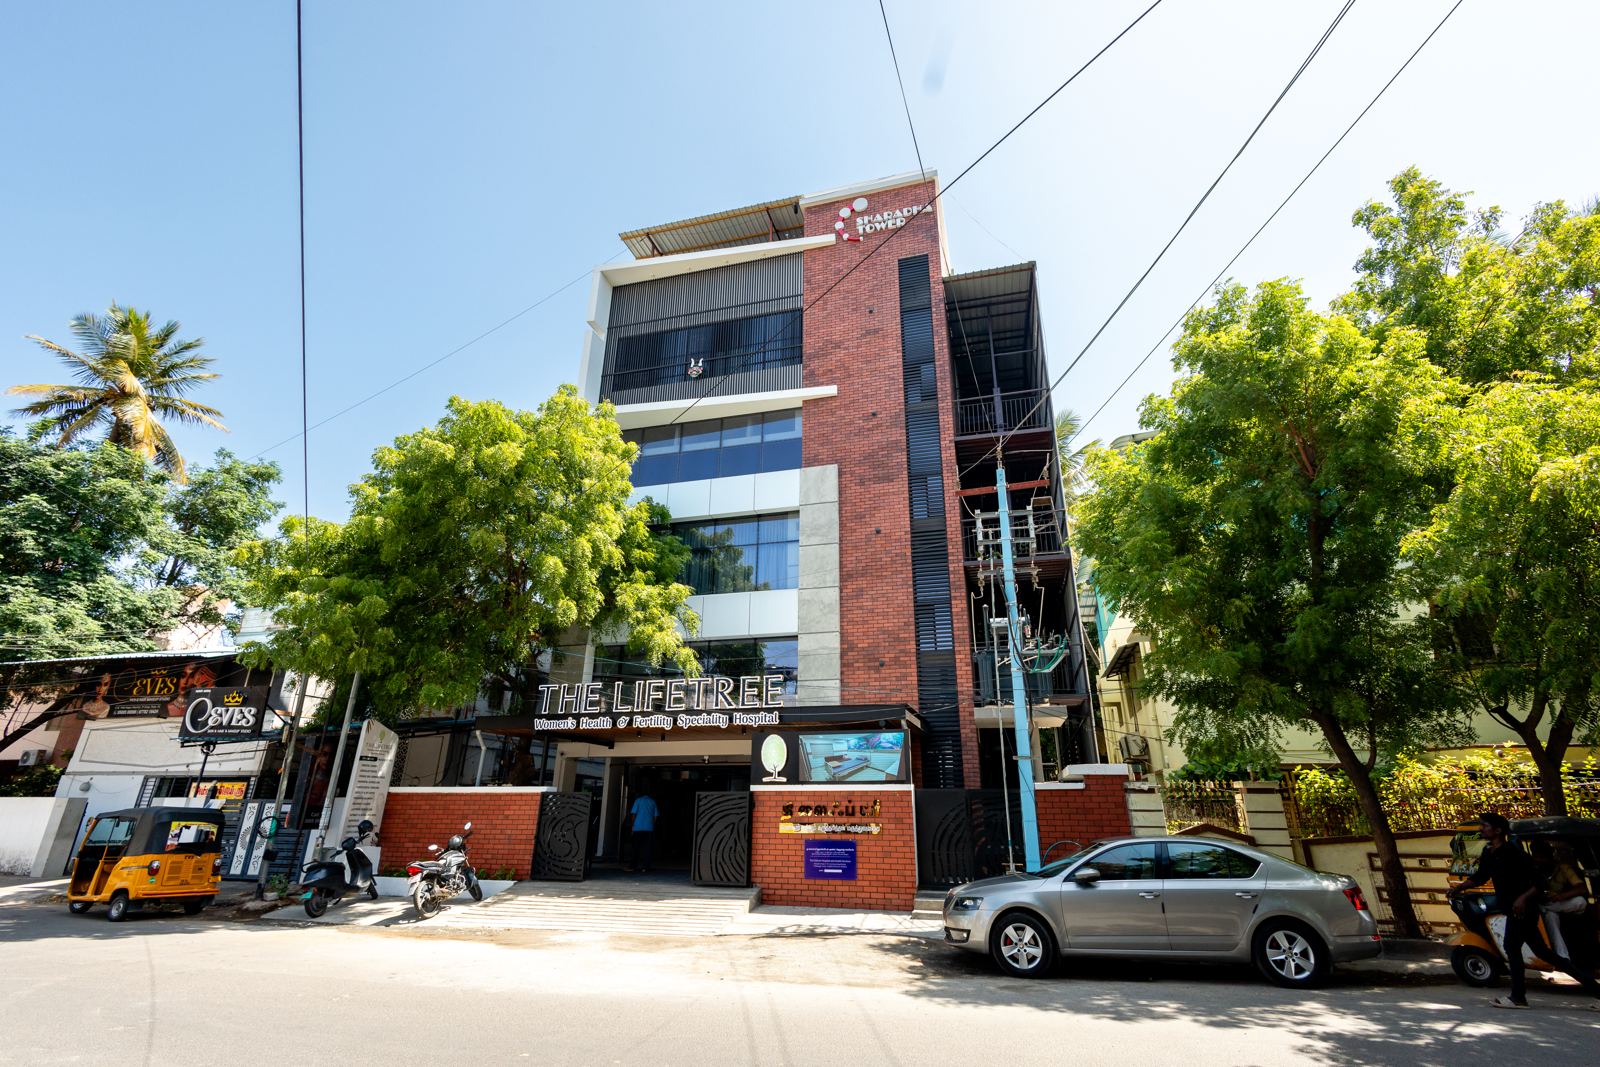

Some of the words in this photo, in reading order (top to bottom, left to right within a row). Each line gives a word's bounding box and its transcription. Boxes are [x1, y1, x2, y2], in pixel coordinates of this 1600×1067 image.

[856, 203, 933, 226] SHARADHA
[856, 217, 906, 235] TOWER
[538, 682, 602, 714] THE
[612, 674, 784, 713] LIFETREE
[534, 716, 576, 730] Women's
[579, 716, 612, 730] Health
[616, 716, 630, 729] &
[633, 714, 673, 730] Fertility
[677, 712, 729, 729] Speciality
[733, 711, 780, 727] Hospital
